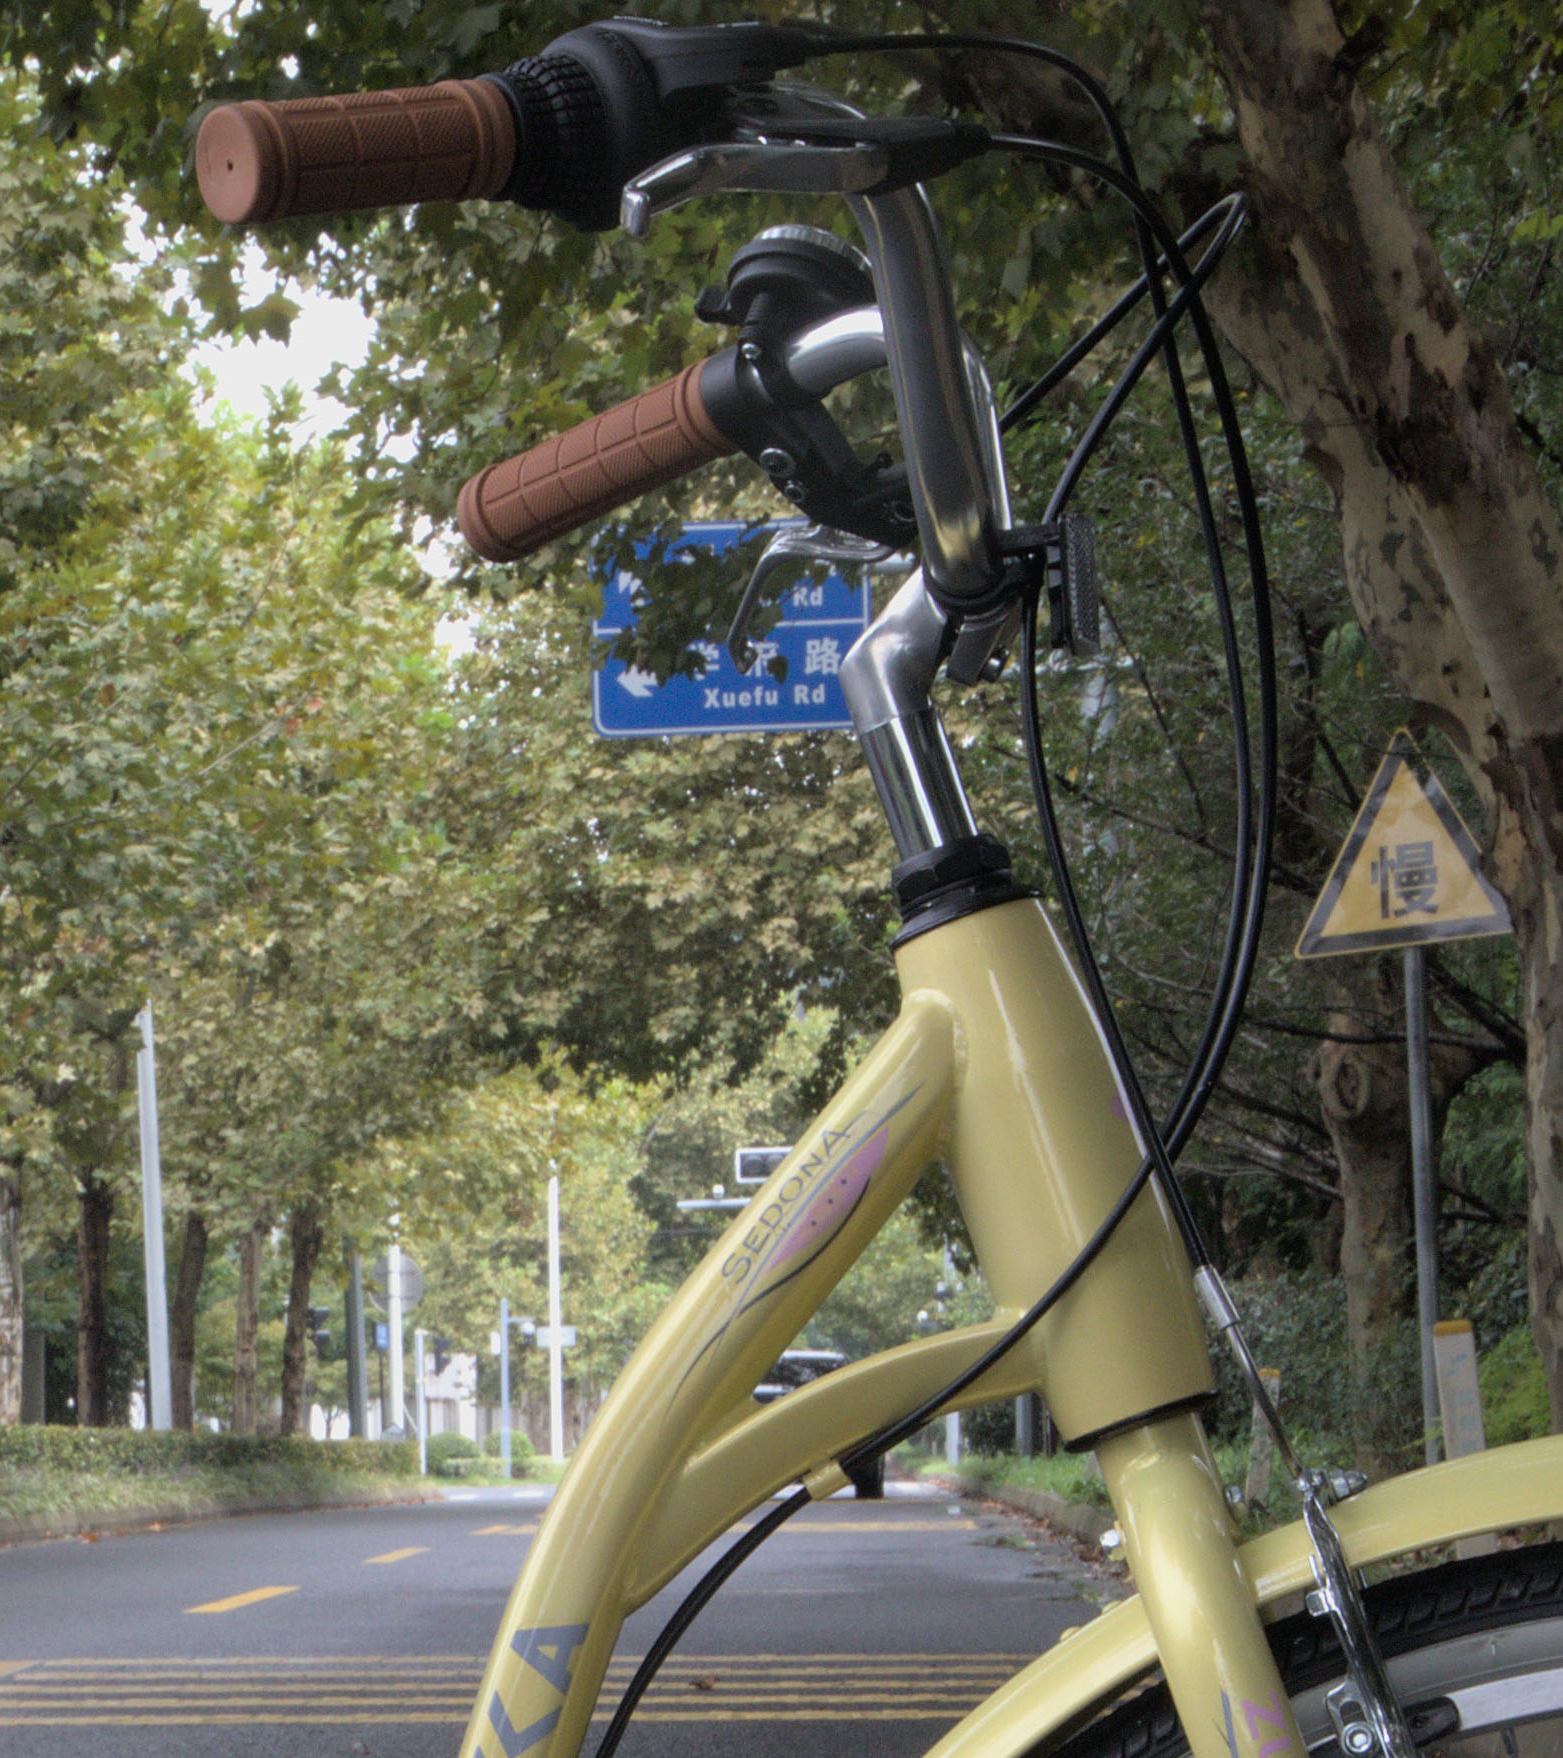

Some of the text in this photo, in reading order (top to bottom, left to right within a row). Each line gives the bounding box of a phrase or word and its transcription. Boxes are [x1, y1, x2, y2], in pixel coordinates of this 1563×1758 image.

[793, 585, 823, 607] Rd
[704, 683, 826, 709] Xuefu Rd
[721, 1110, 868, 1285] SEDONA
